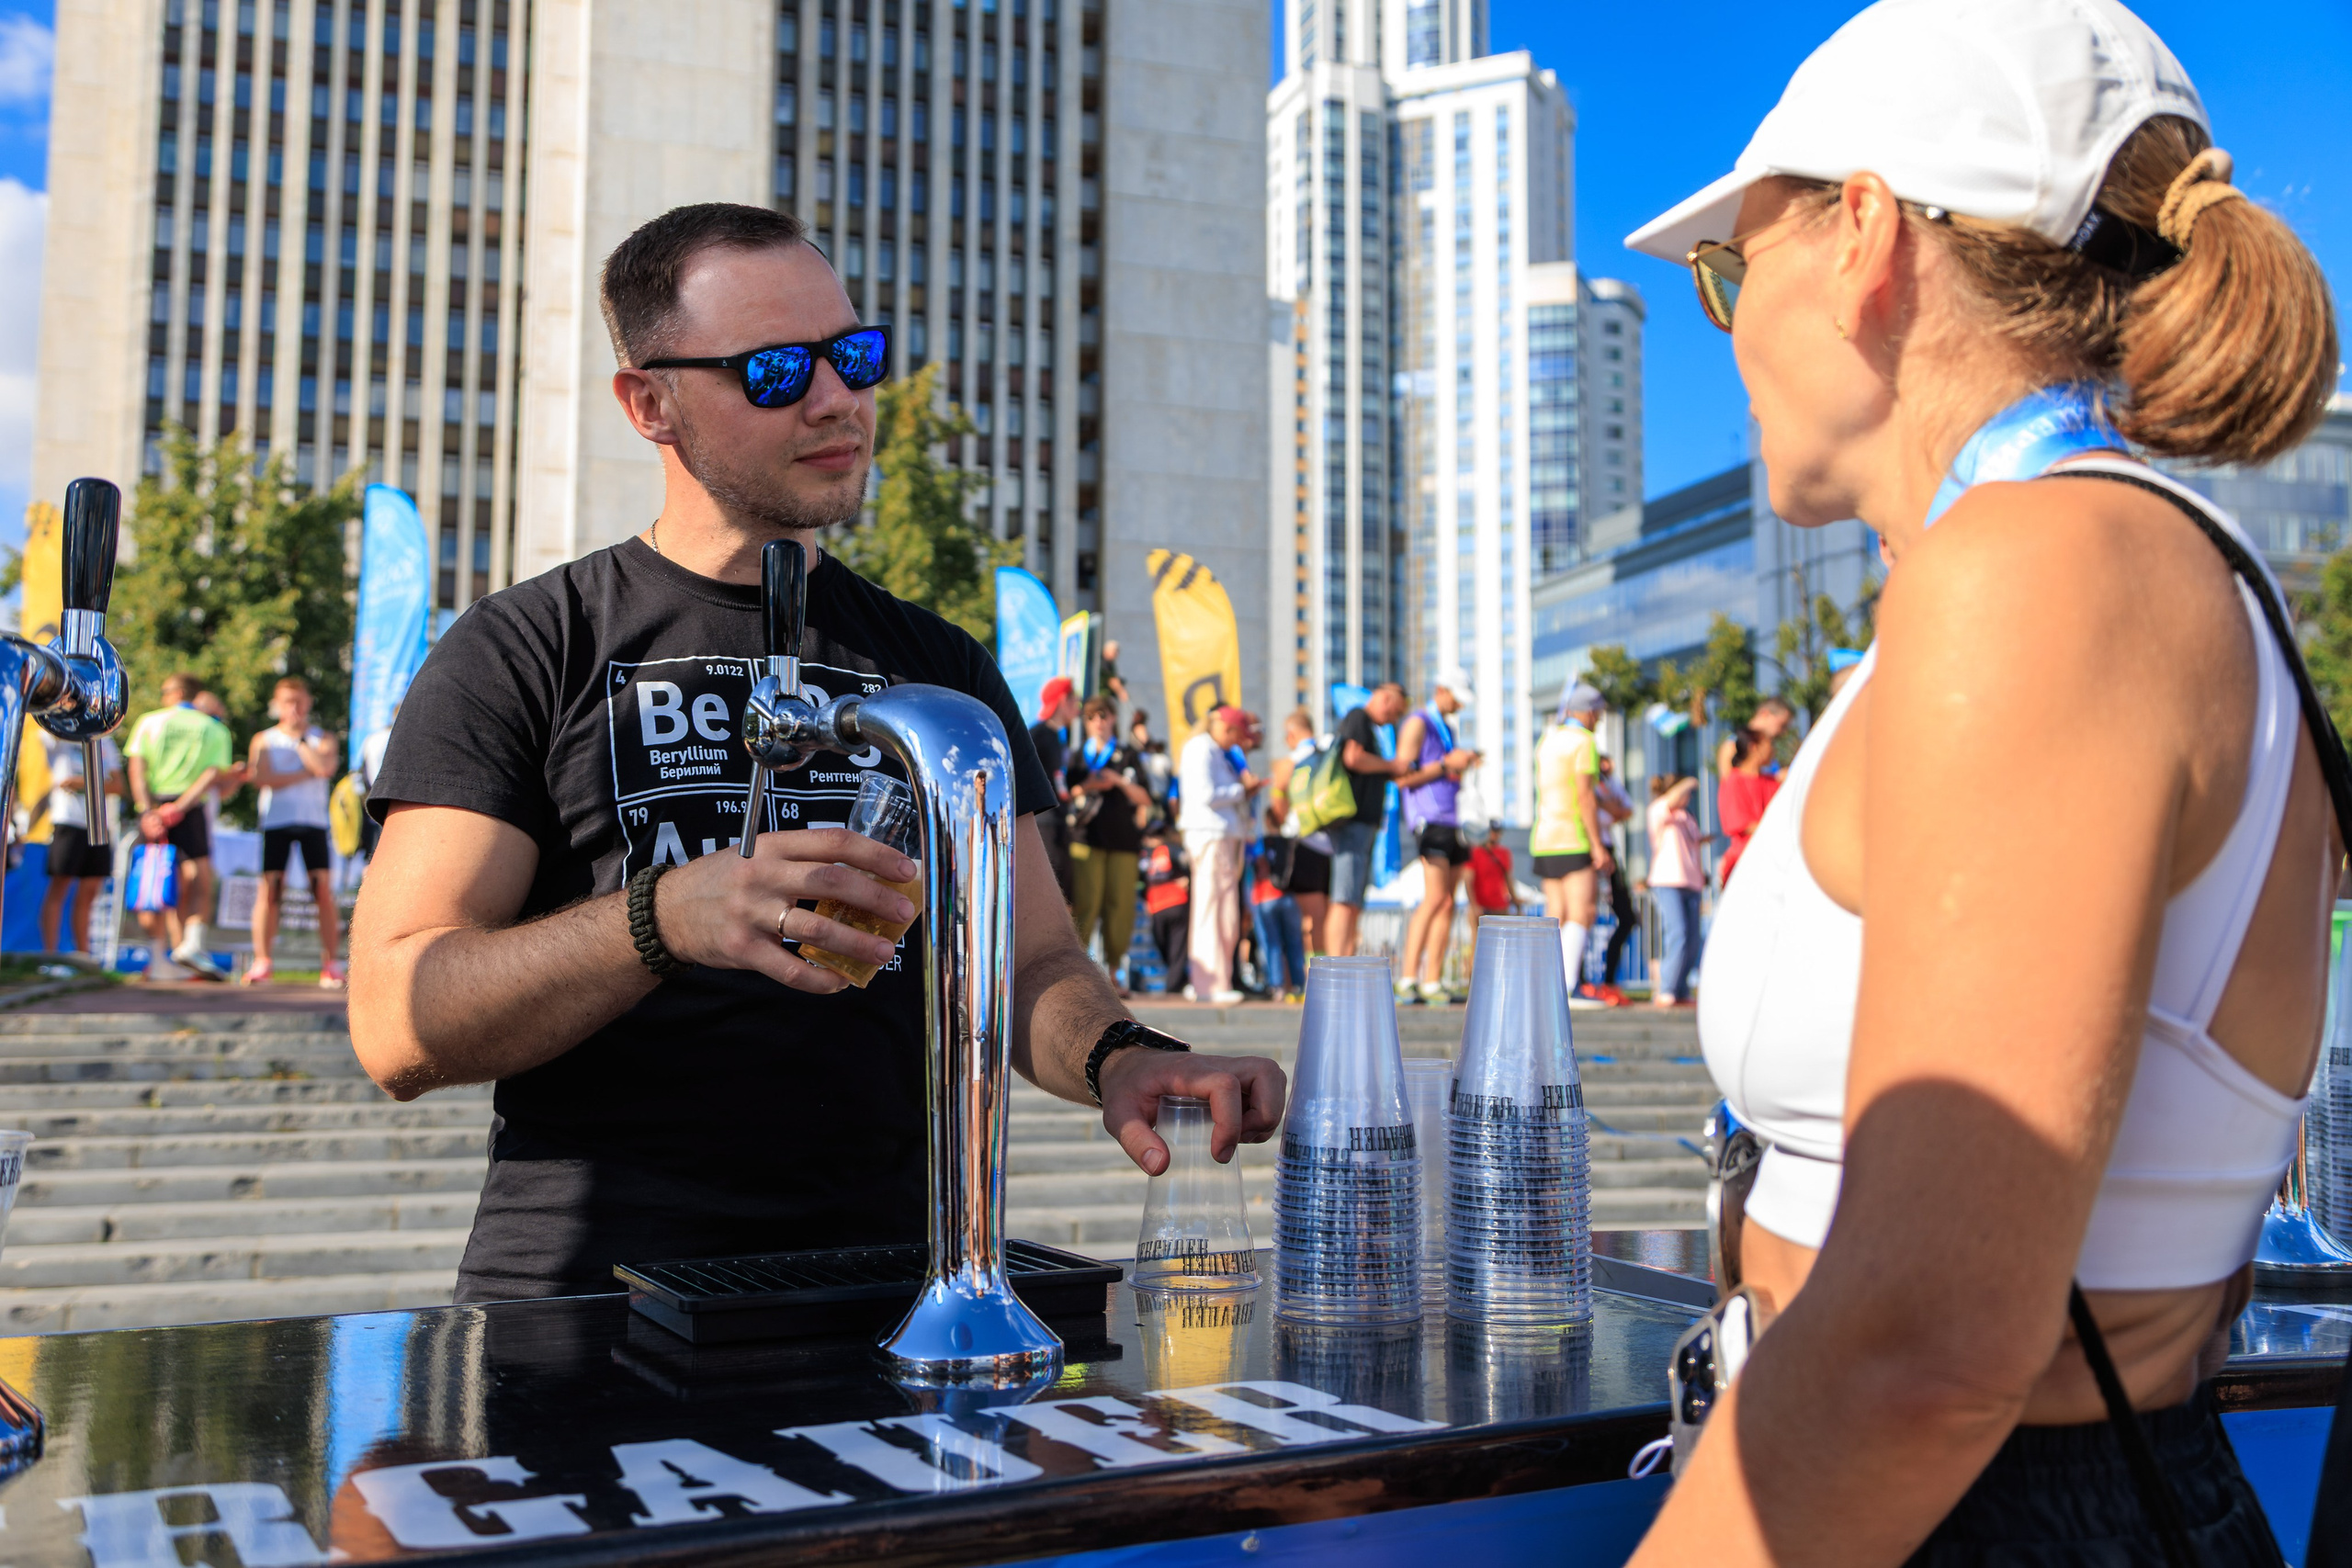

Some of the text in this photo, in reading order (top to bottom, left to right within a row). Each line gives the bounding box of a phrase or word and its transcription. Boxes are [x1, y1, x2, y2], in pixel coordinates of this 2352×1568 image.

[615, 670, 627, 685] 4
[706, 664, 744, 677] 9.0122
[636, 681, 731, 746] Be
[650, 745, 729, 766] Beryllium
[660, 762, 721, 780] Бериллий
[809, 770, 863, 784] Рентген
[716, 800, 748, 814] 196.9
[781, 802, 799, 819] 68
[628, 807, 649, 826] 79
[0, 1381, 1451, 1568] RGAUER
